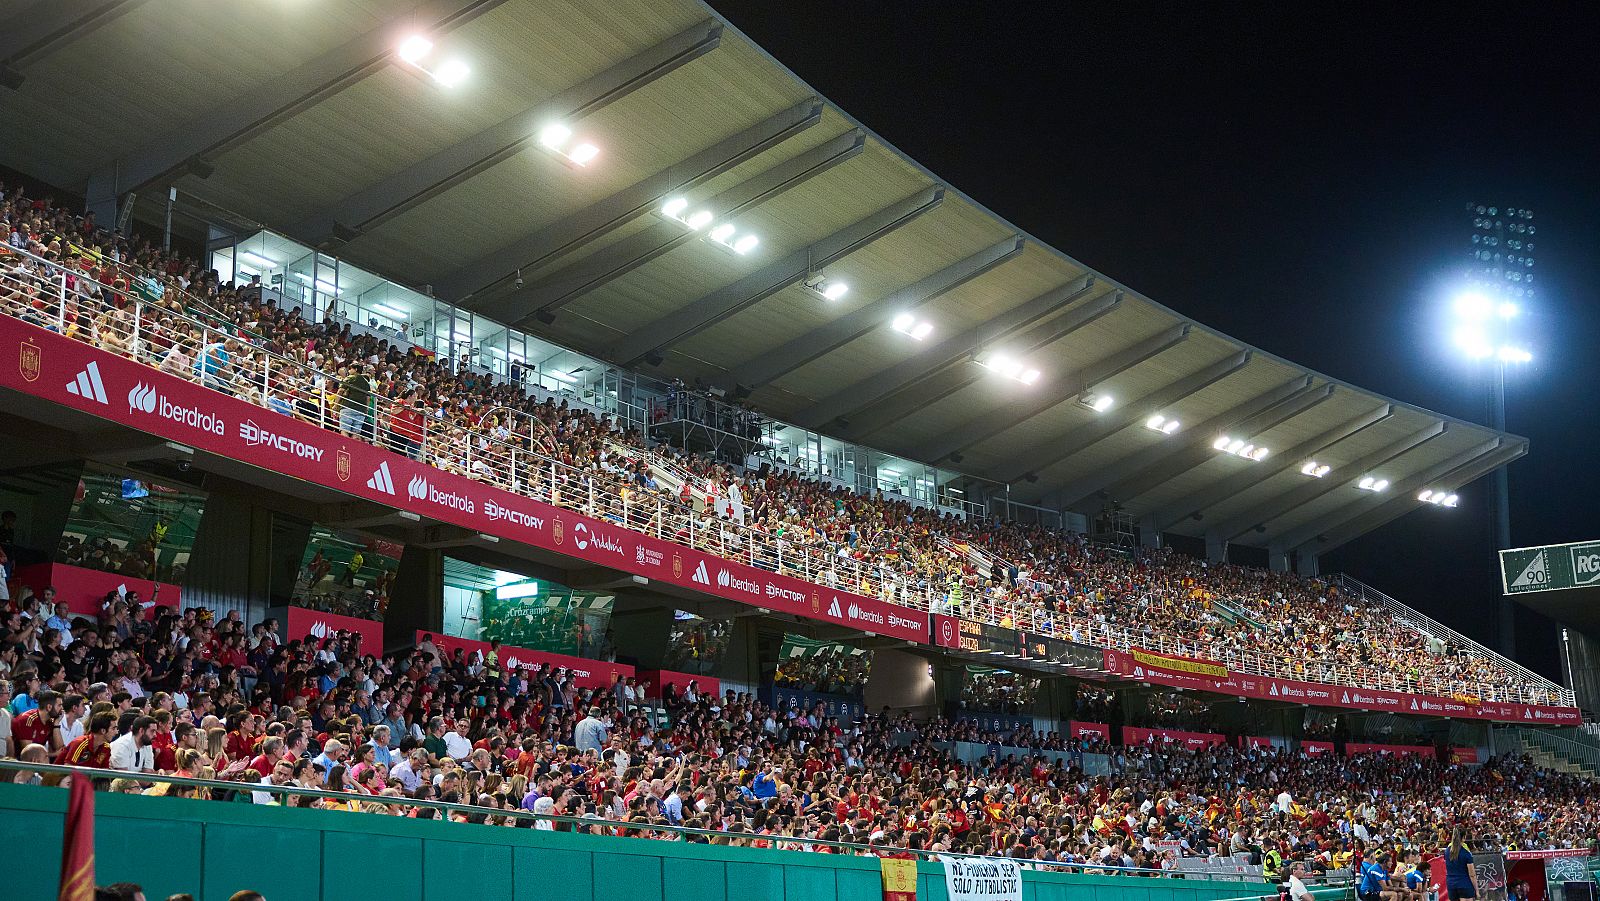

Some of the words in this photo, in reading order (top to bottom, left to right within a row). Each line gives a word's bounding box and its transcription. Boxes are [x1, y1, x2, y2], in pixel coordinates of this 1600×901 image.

[159, 395, 225, 436] Iberdrola
[429, 484, 475, 514] Iberdrola
[1577, 554, 1600, 574] RG
[730, 574, 760, 594] Iberdrola
[1526, 570, 1545, 584] 90
[858, 607, 884, 625] Iberdrola
[952, 862, 963, 876] NO
[1001, 863, 1017, 877] SER
[953, 878, 971, 893] SOLO
[975, 879, 1017, 894] FUTBOLISTAS
